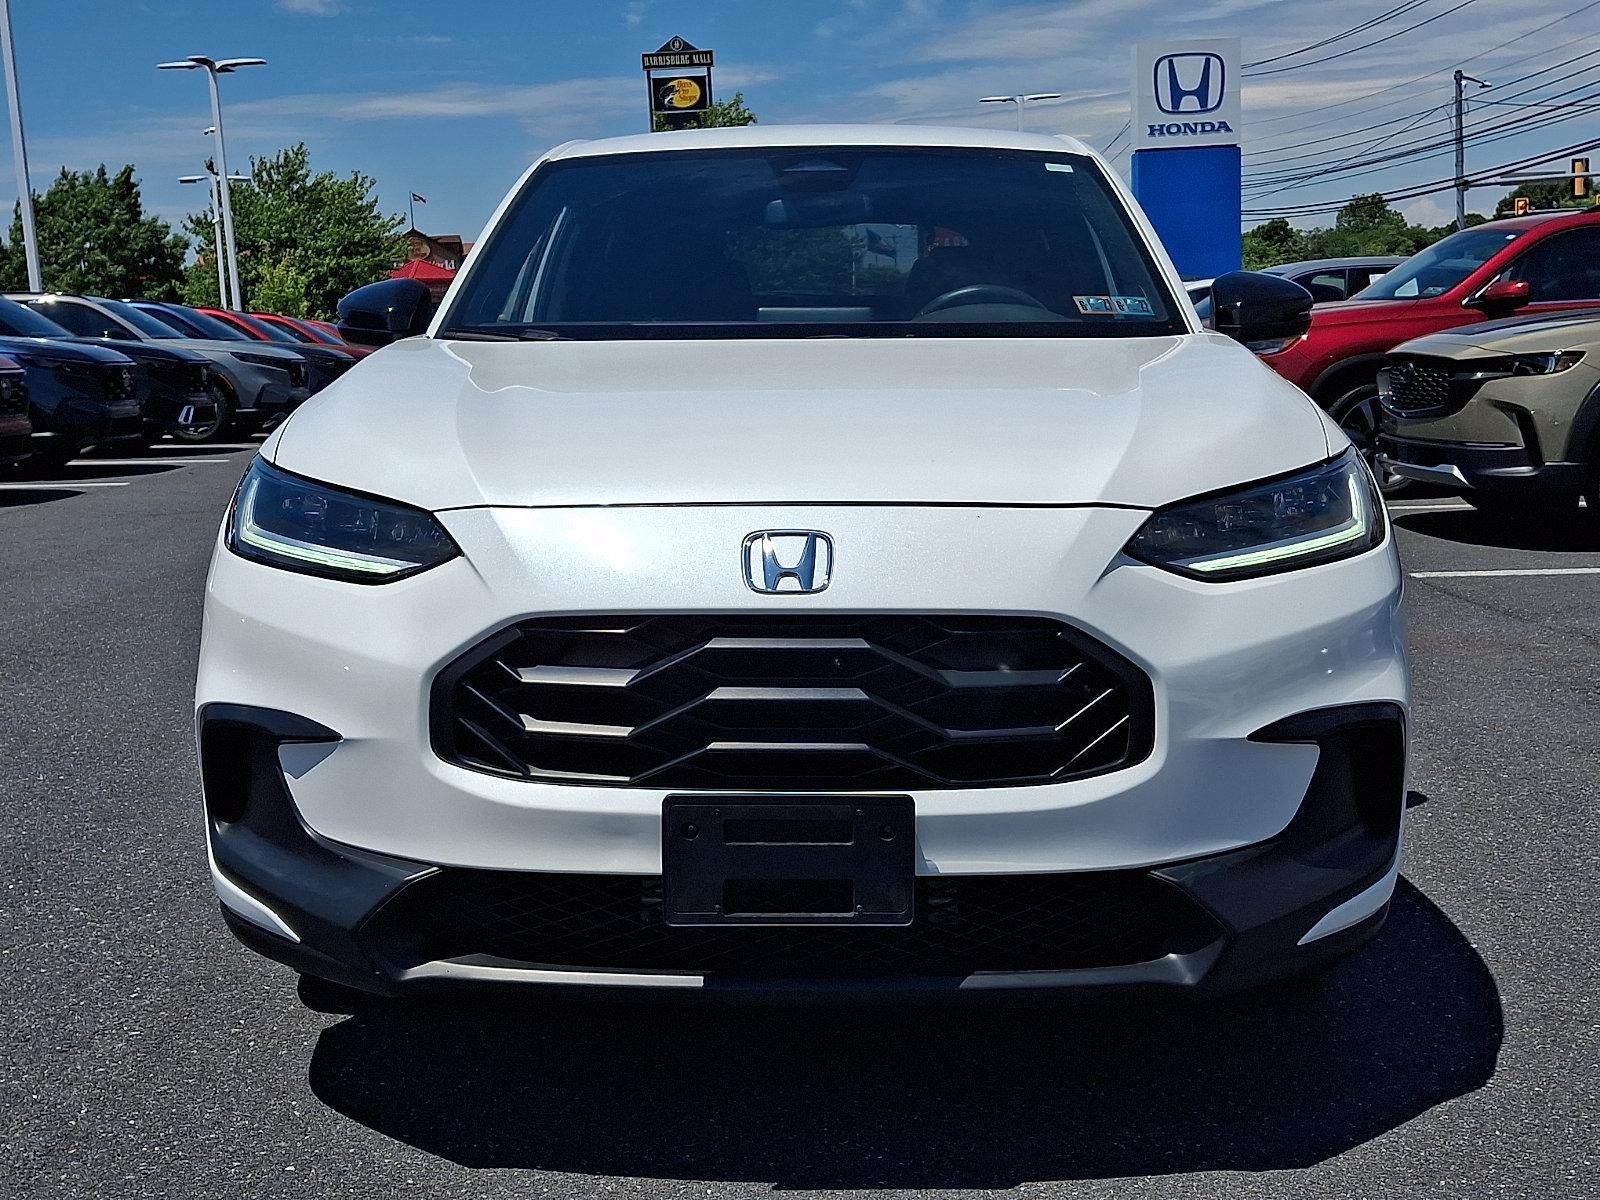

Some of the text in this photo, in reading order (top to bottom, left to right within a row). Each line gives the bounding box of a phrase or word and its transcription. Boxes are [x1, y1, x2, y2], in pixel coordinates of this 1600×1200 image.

[644, 53, 711, 66] HARRISBURG MALL
[1147, 121, 1233, 136] HONDA
